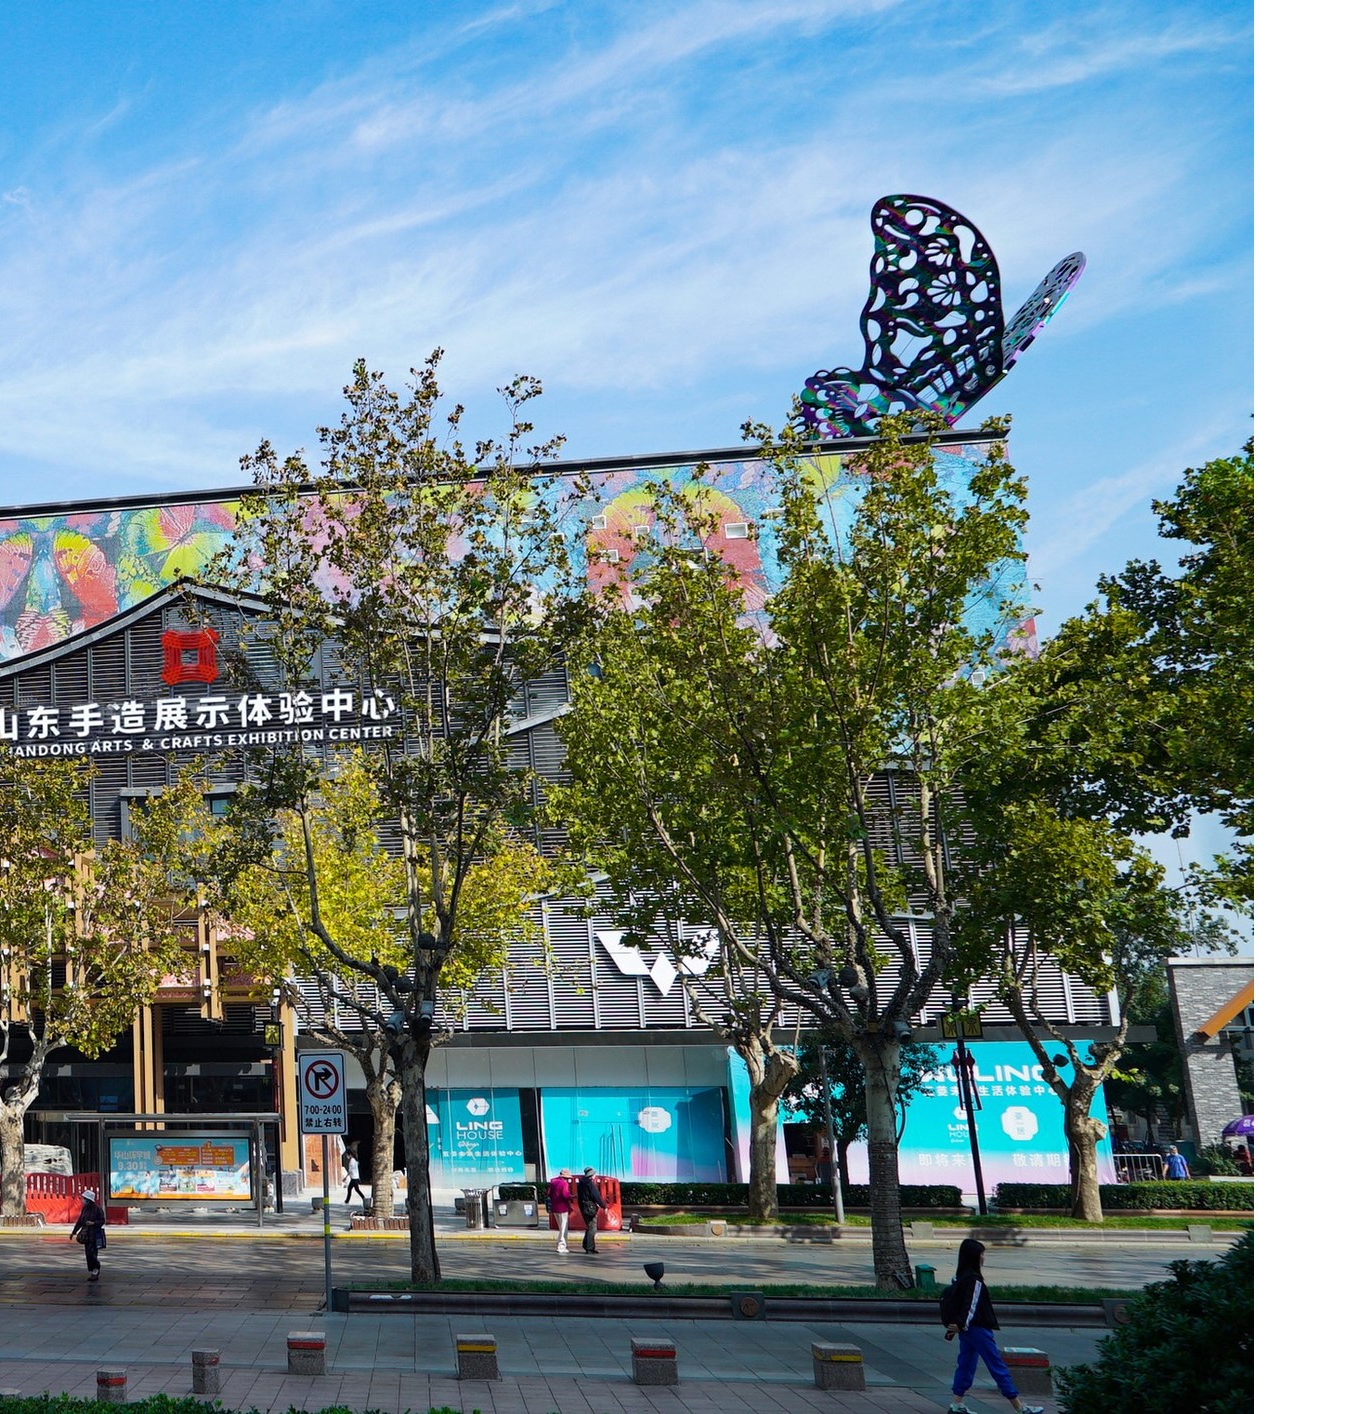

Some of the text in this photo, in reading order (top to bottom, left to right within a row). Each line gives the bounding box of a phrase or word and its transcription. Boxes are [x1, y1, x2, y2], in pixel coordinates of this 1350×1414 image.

[91, 739, 133, 753] ARTS
[142, 738, 154, 750] &
[161, 734, 223, 750] CRAFTS
[228, 728, 324, 746] EXHIBITION
[329, 726, 392, 740] CENTER
[305, 1117, 342, 1128] 禁止右转
[456, 1121, 503, 1131] LING
[457, 1131, 504, 1140] HOUSE
[118, 1161, 138, 1170] 9.30
